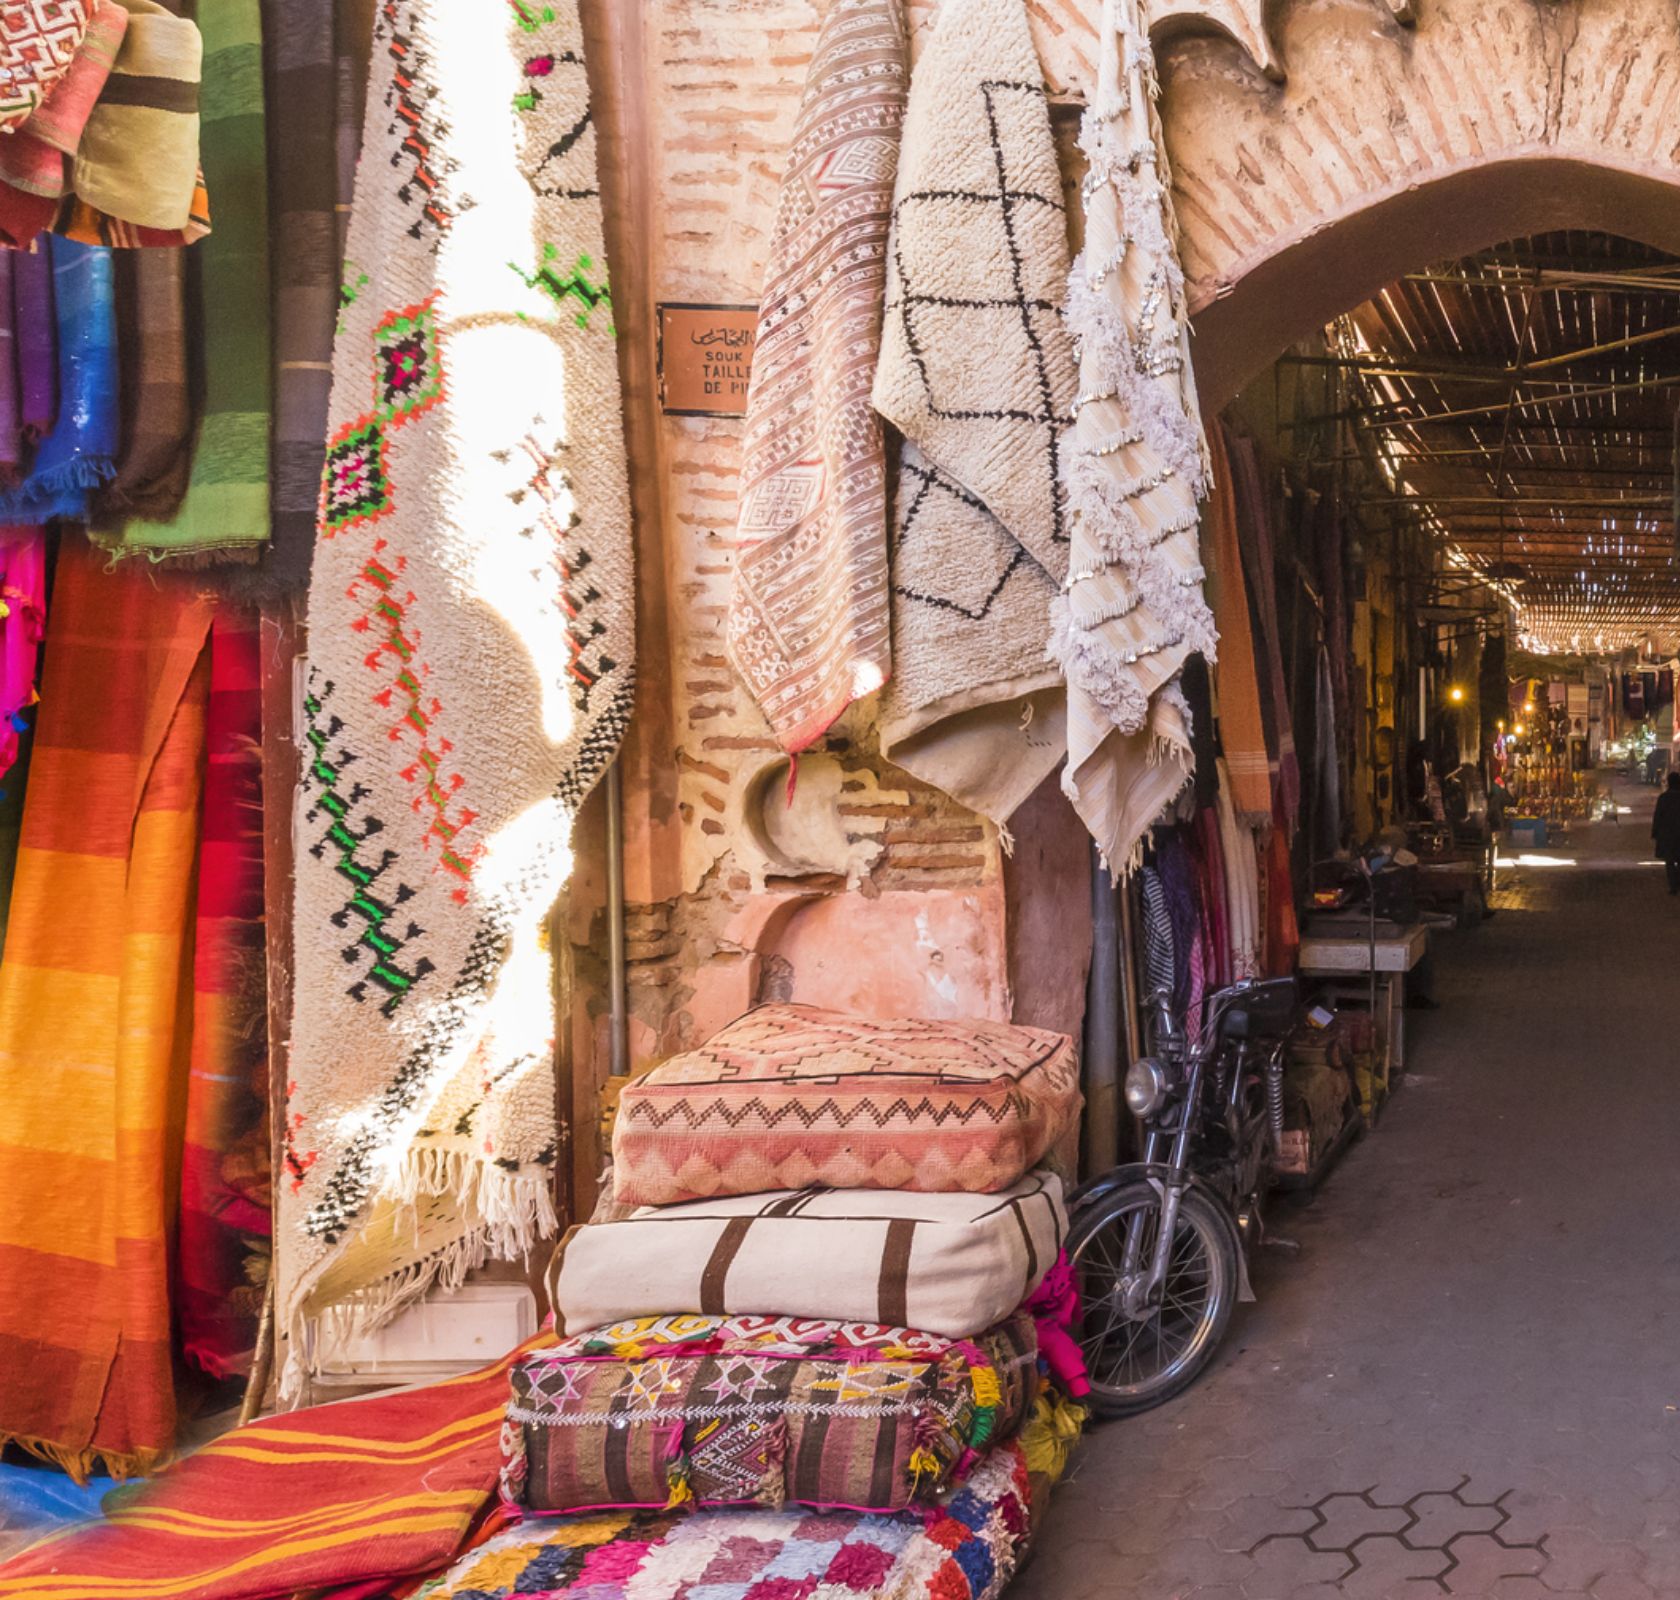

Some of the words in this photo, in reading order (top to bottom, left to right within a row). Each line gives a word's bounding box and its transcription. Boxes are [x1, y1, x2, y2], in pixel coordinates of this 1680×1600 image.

[705, 351, 743, 362] SOUK
[704, 381, 721, 394] DE
[731, 382, 749, 394] PI
